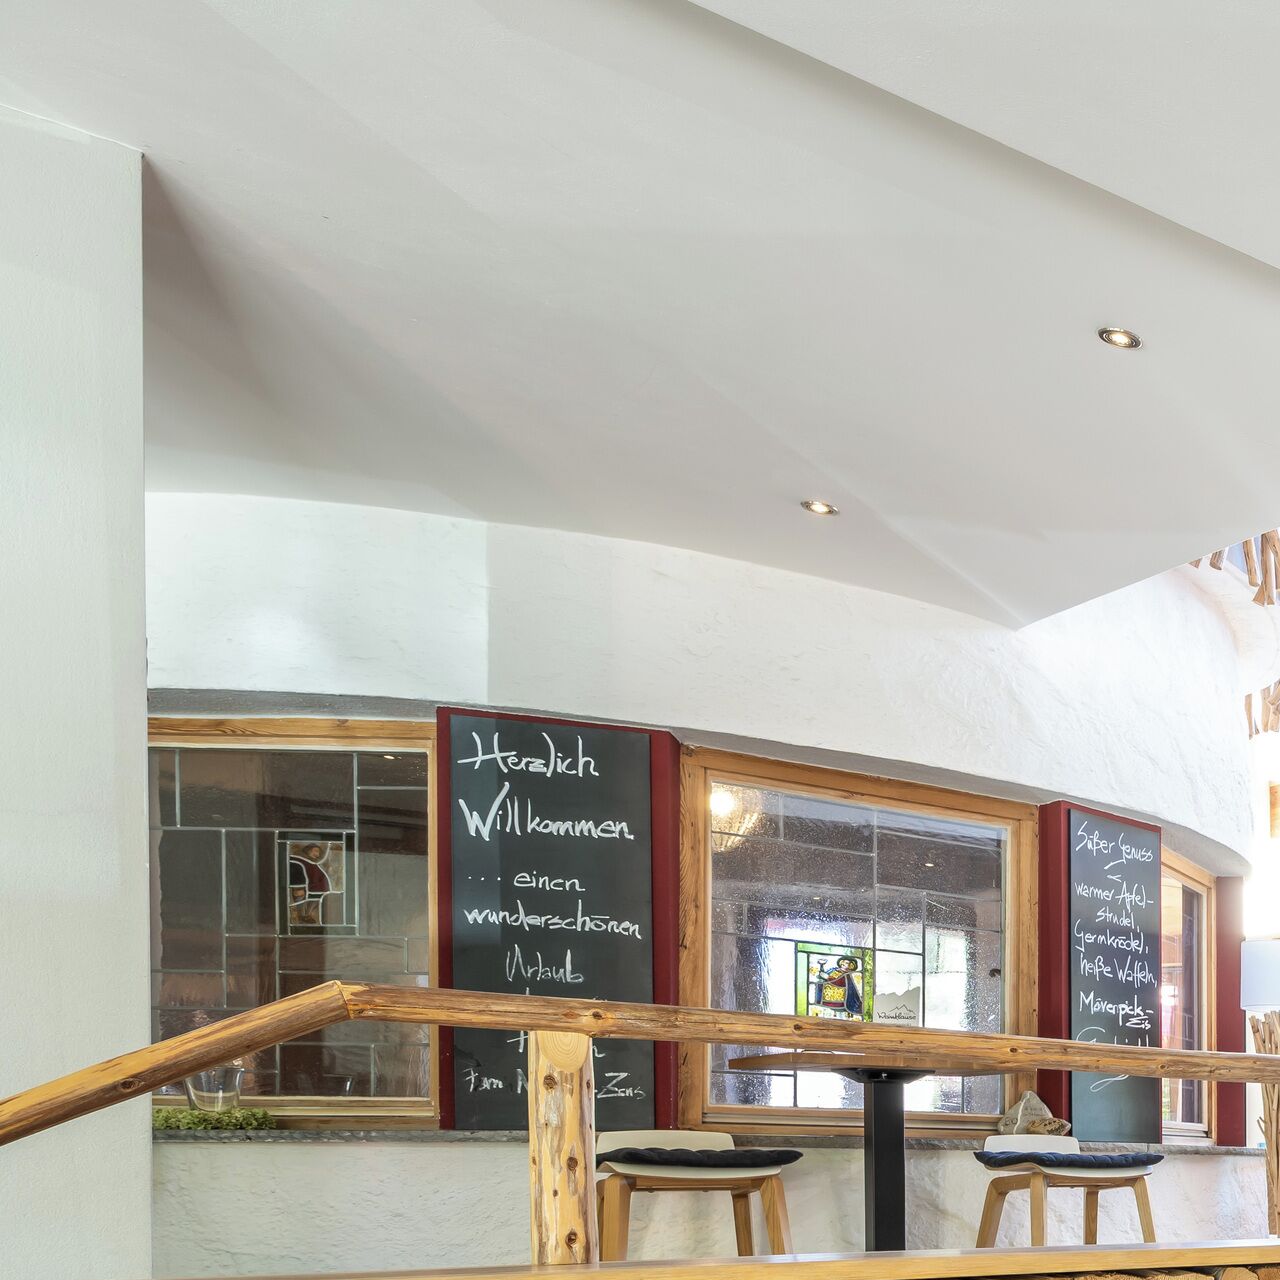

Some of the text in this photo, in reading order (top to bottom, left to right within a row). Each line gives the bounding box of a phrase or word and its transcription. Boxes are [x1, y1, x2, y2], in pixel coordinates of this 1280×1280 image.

[457, 731, 600, 778] Herzlich
[458, 781, 635, 842] Willkommen
[1075, 820, 1154, 864] Süßer Genuss
[513, 870, 586, 892] einen
[463, 898, 643, 940] wunderschönen
[505, 943, 585, 984] Urlaub
